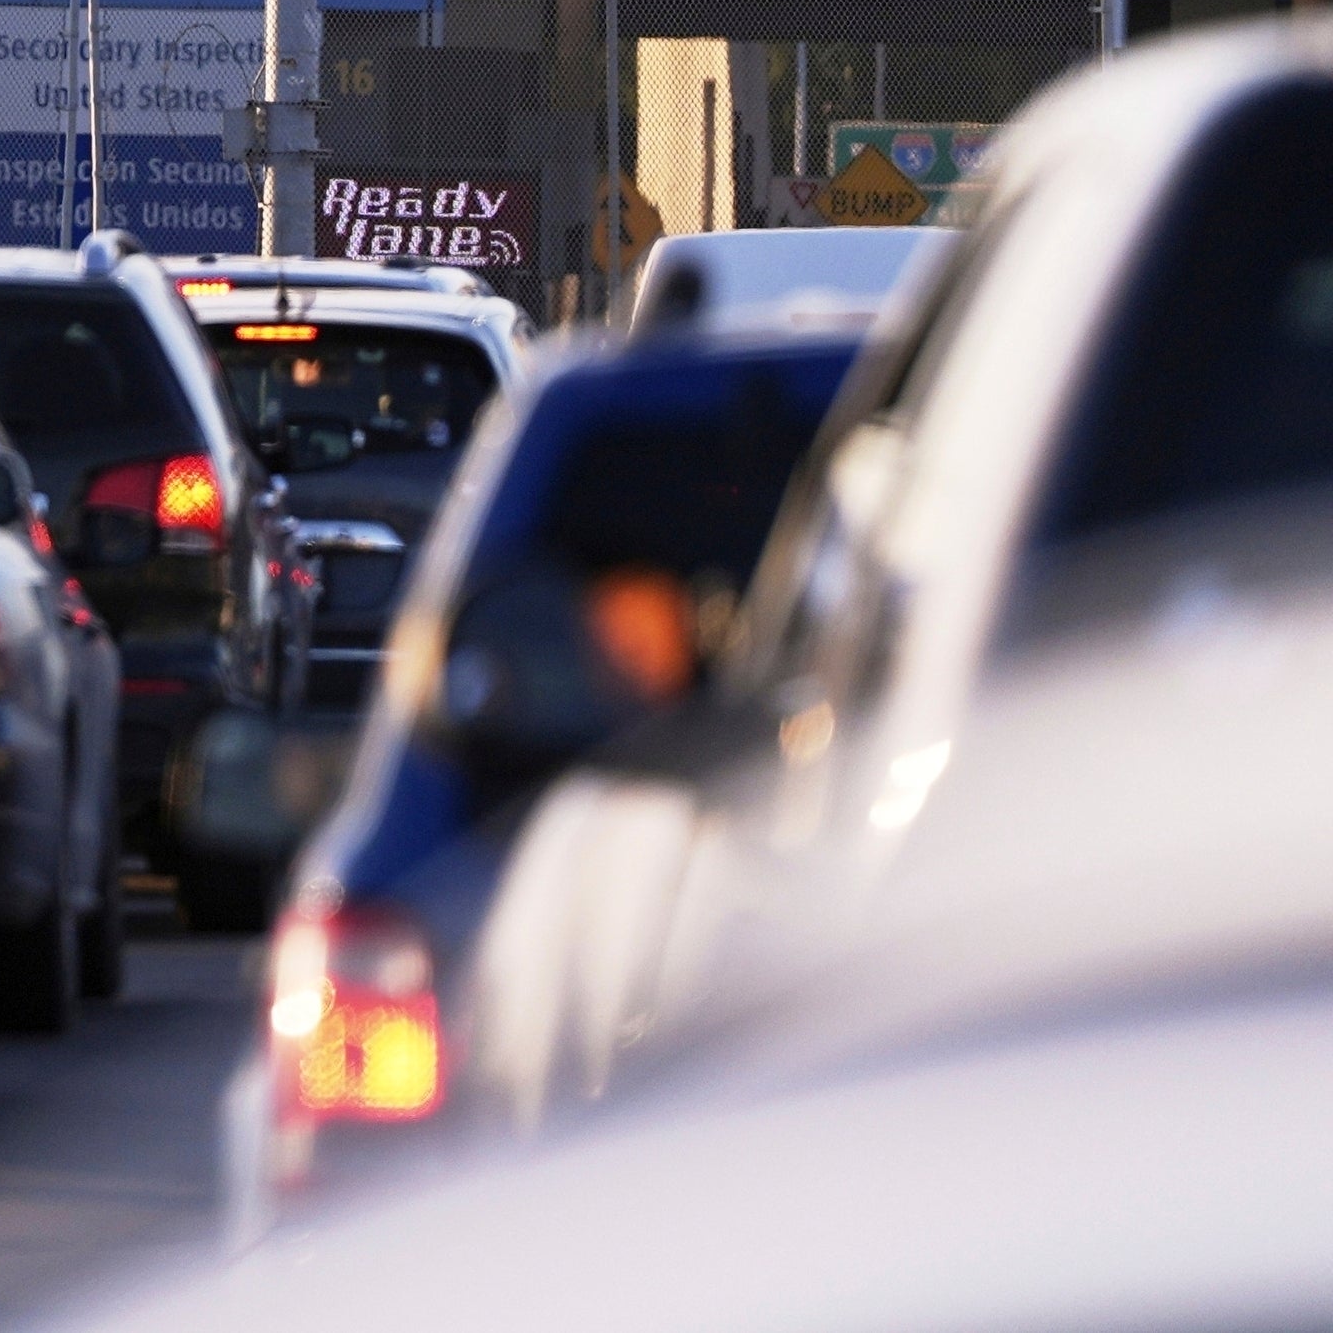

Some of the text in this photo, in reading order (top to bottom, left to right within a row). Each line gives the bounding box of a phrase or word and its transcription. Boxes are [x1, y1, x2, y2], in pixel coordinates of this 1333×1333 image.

[334, 58, 376, 95] 16
[137, 84, 226, 111] States
[143, 201, 244, 230] Unidos
[322, 178, 508, 235] Ready
[832, 187, 916, 218] BUMP
